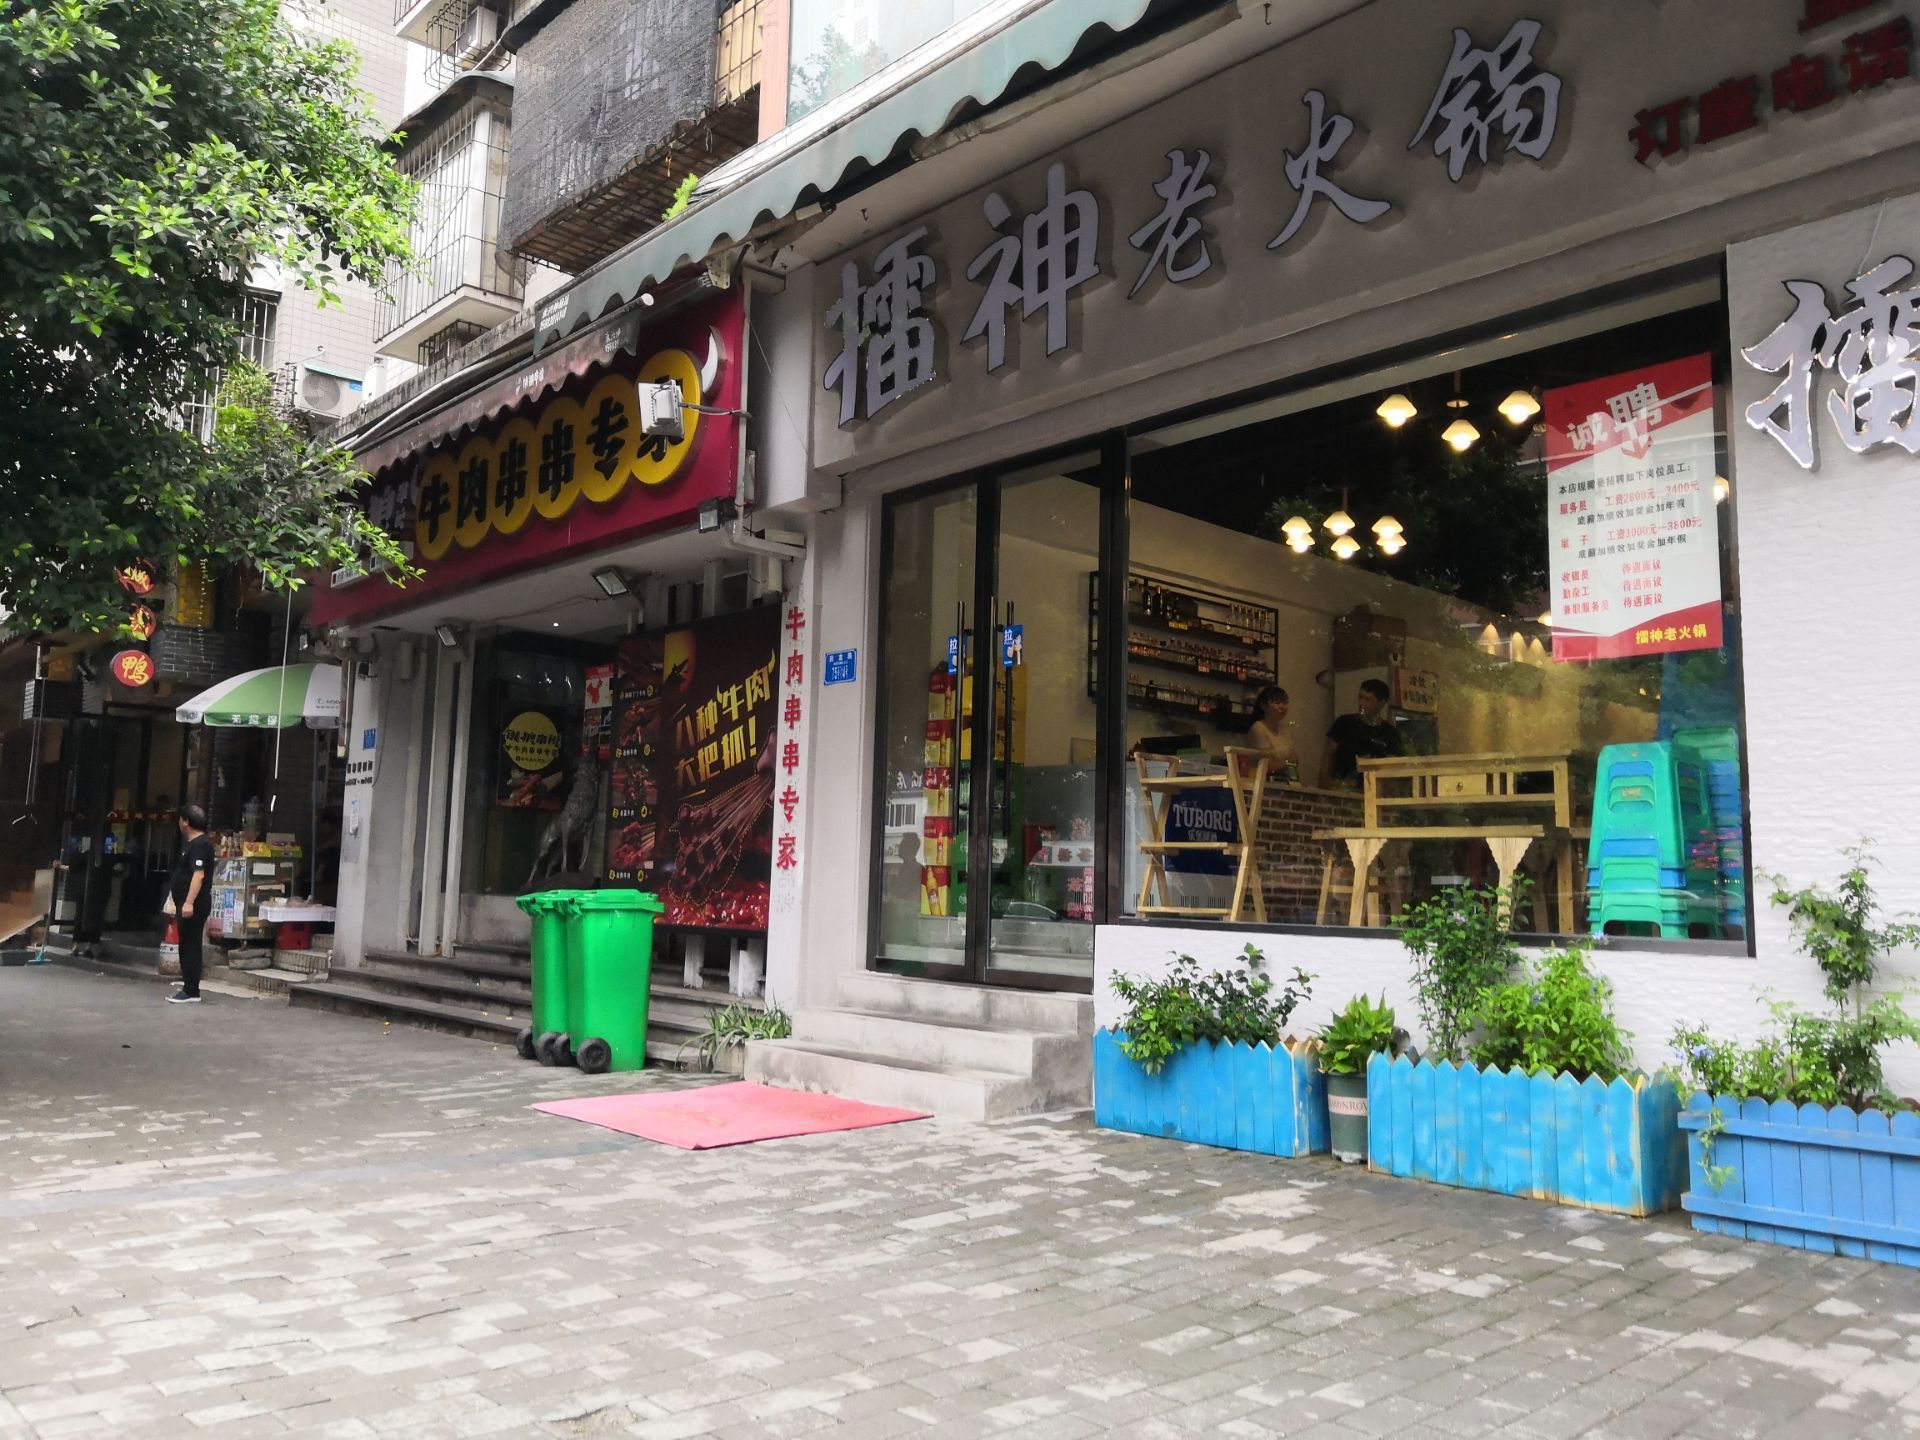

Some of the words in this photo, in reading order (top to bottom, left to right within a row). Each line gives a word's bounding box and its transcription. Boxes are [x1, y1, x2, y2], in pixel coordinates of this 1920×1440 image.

[824, 19, 1563, 429] 擂神老火锅
[1567, 383, 1662, 450] 诚聘
[1560, 500, 1587, 515] 服务员
[1623, 577, 1662, 591] 待遇面议
[1624, 594, 1662, 608] 待遇面议
[1004, 629, 1013, 641] 拉
[1636, 624, 1707, 644] 擂神老火锅
[122, 655, 149, 685] 鸭
[676, 650, 775, 750] 八种牛肉
[776, 606, 805, 870] 牛肉串串专家
[1173, 804, 1232, 833] TUBORG
